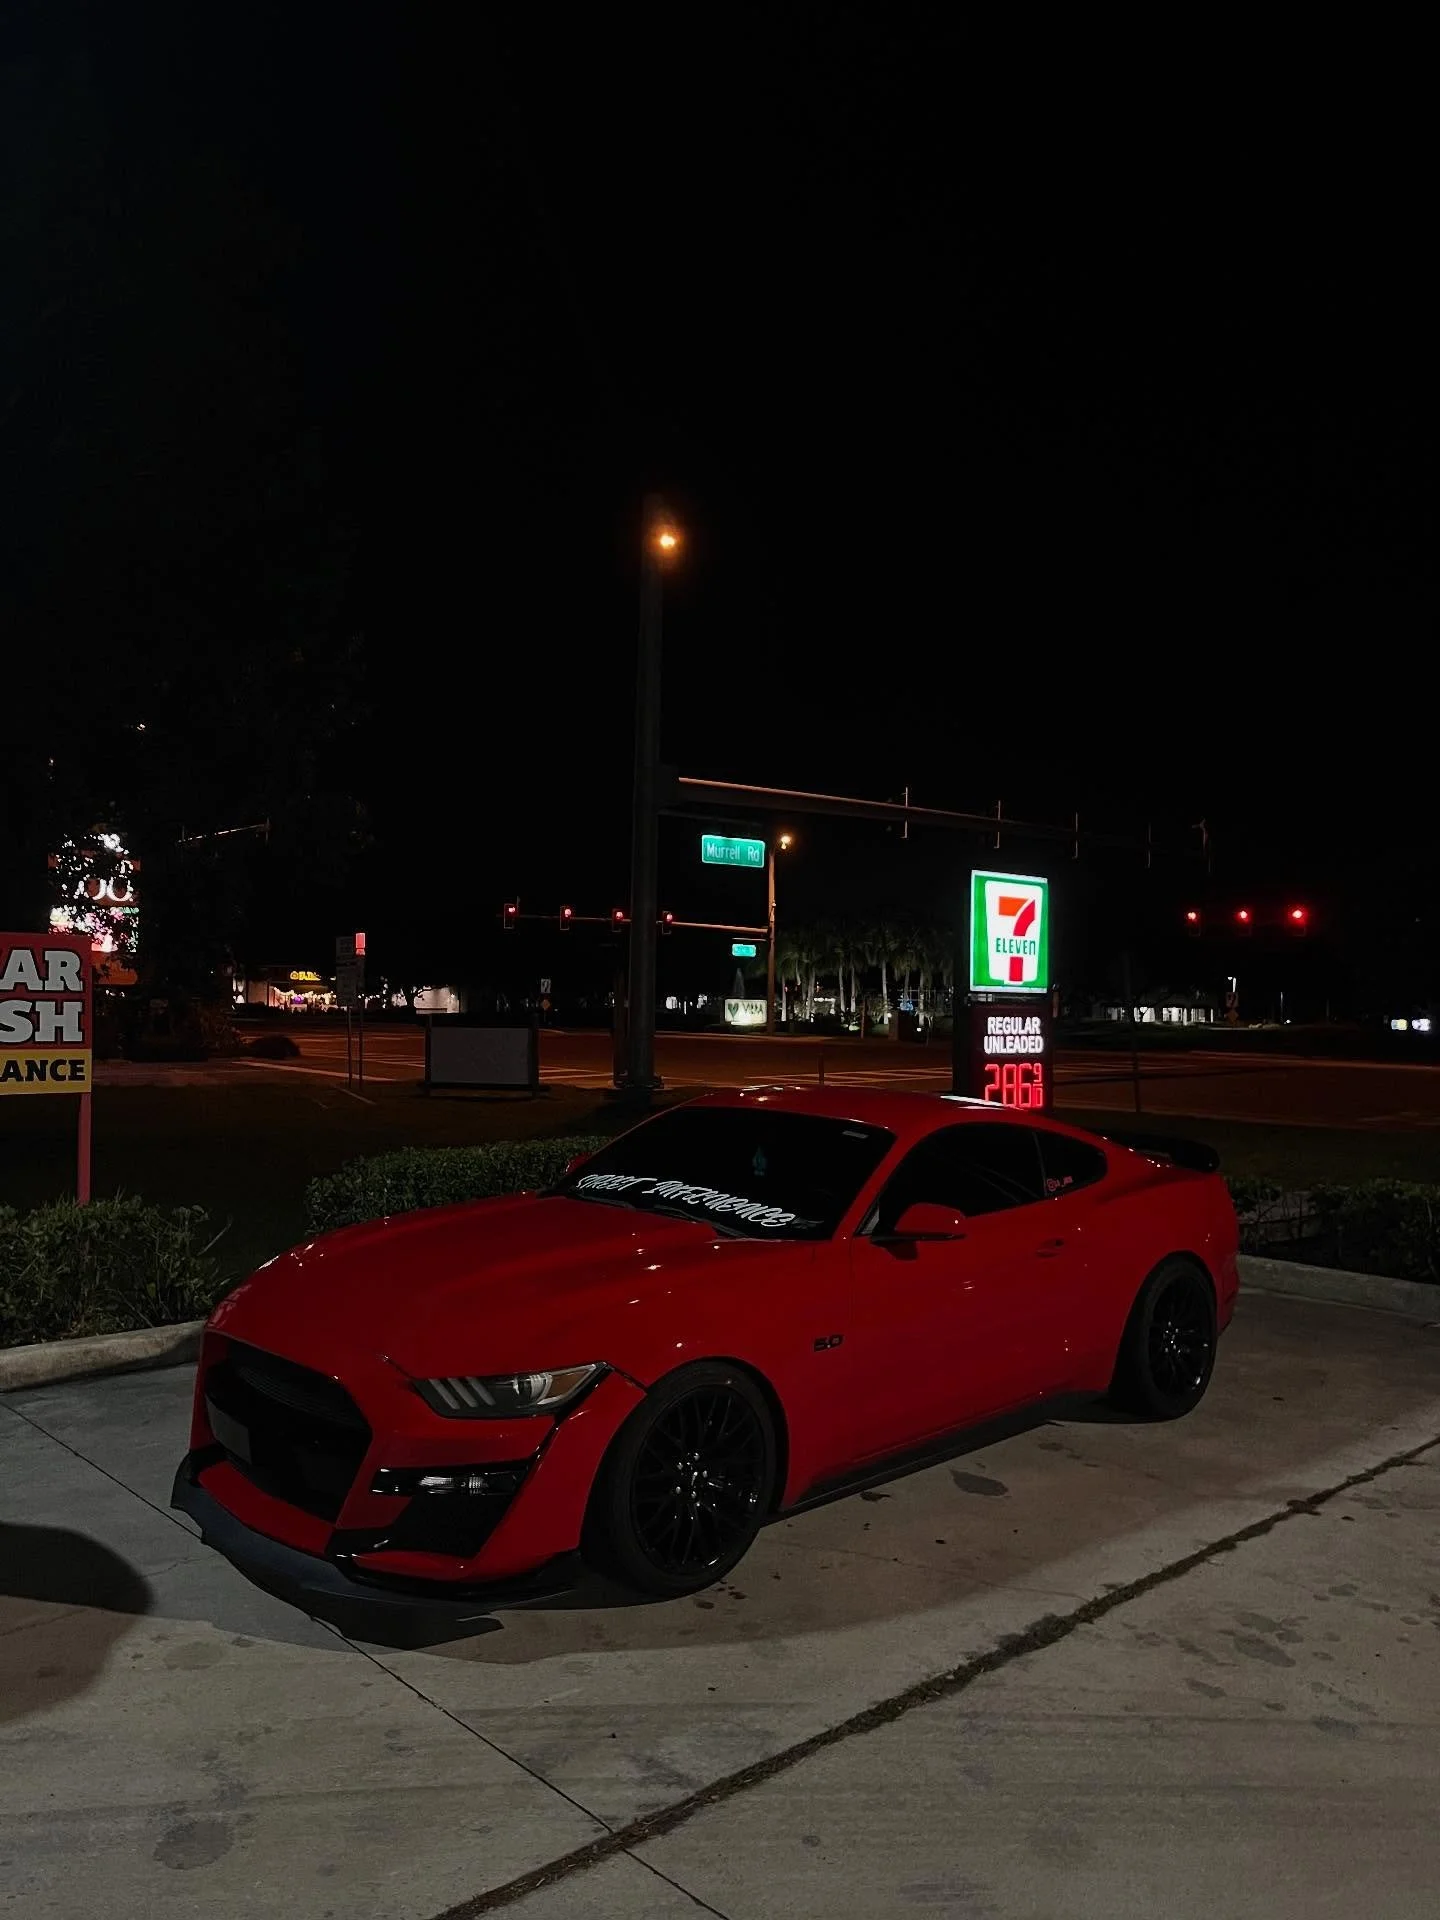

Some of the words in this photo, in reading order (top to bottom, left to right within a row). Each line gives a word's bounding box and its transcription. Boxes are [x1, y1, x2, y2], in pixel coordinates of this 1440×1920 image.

[706, 842, 740, 861] Murrell
[747, 846, 760, 862] Rd
[998, 896, 1036, 982] 7
[987, 1016, 1041, 1035] REGULAR
[983, 1035, 1044, 1054] UNLEADED
[576, 1174, 658, 1191] STREET
[814, 1334, 843, 1352] 5.0
